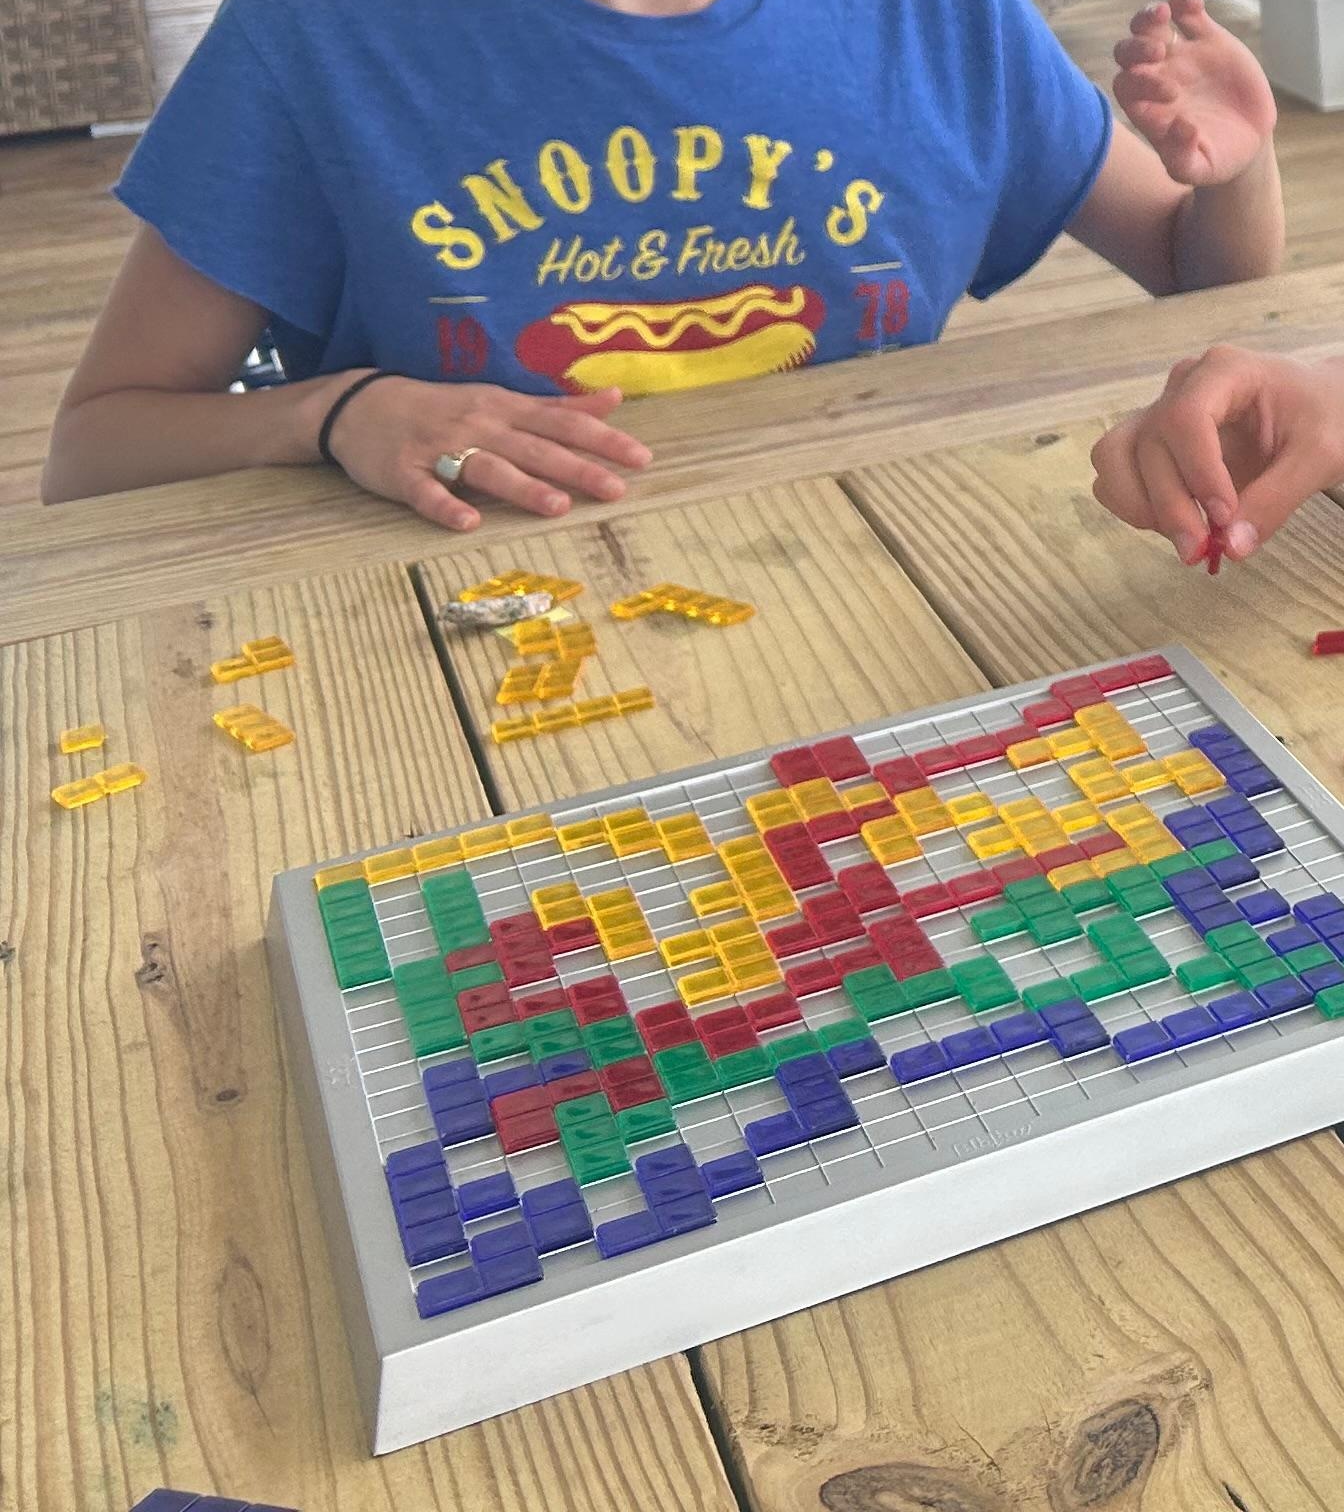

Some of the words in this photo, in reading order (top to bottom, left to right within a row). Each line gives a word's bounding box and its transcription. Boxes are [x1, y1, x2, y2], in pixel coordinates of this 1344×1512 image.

[411, 125, 886, 271] SNOOPY'S
[537, 234, 625, 286] Hot
[630, 228, 669, 280] &
[677, 215, 806, 276] Fresh
[436, 315, 488, 376] 19
[853, 278, 910, 342] 78
